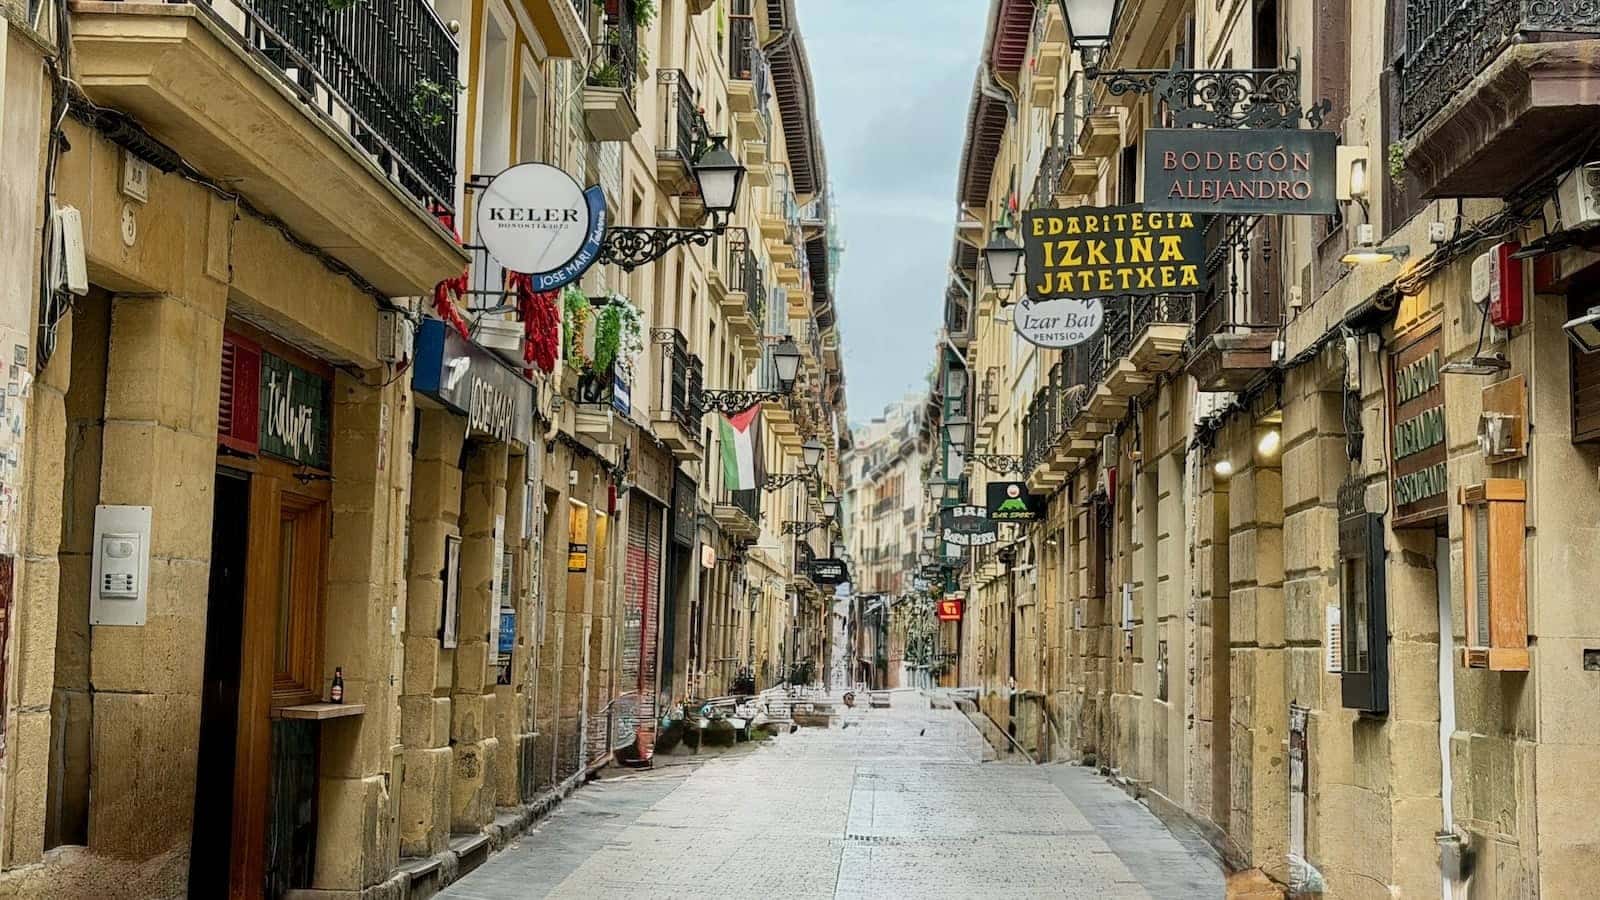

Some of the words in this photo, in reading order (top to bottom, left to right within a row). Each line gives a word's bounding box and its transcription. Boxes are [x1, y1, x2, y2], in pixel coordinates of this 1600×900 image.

[1163, 145, 1312, 172] BODEGÓN
[1167, 178, 1313, 204] ALEJANDRO
[488, 207, 579, 222] KELER
[1042, 231, 1185, 268] IZKIÑA
[540, 273, 566, 288] JOSE
[567, 250, 591, 274] MARI
[1037, 264, 1200, 295] JATETXEA
[1022, 314, 1061, 331] Izar
[1063, 311, 1096, 329] Bat
[1034, 332, 1085, 341] PENTSIOA
[465, 374, 494, 439] JOSE
[488, 386, 516, 446] MARI
[953, 507, 986, 518] BAR
